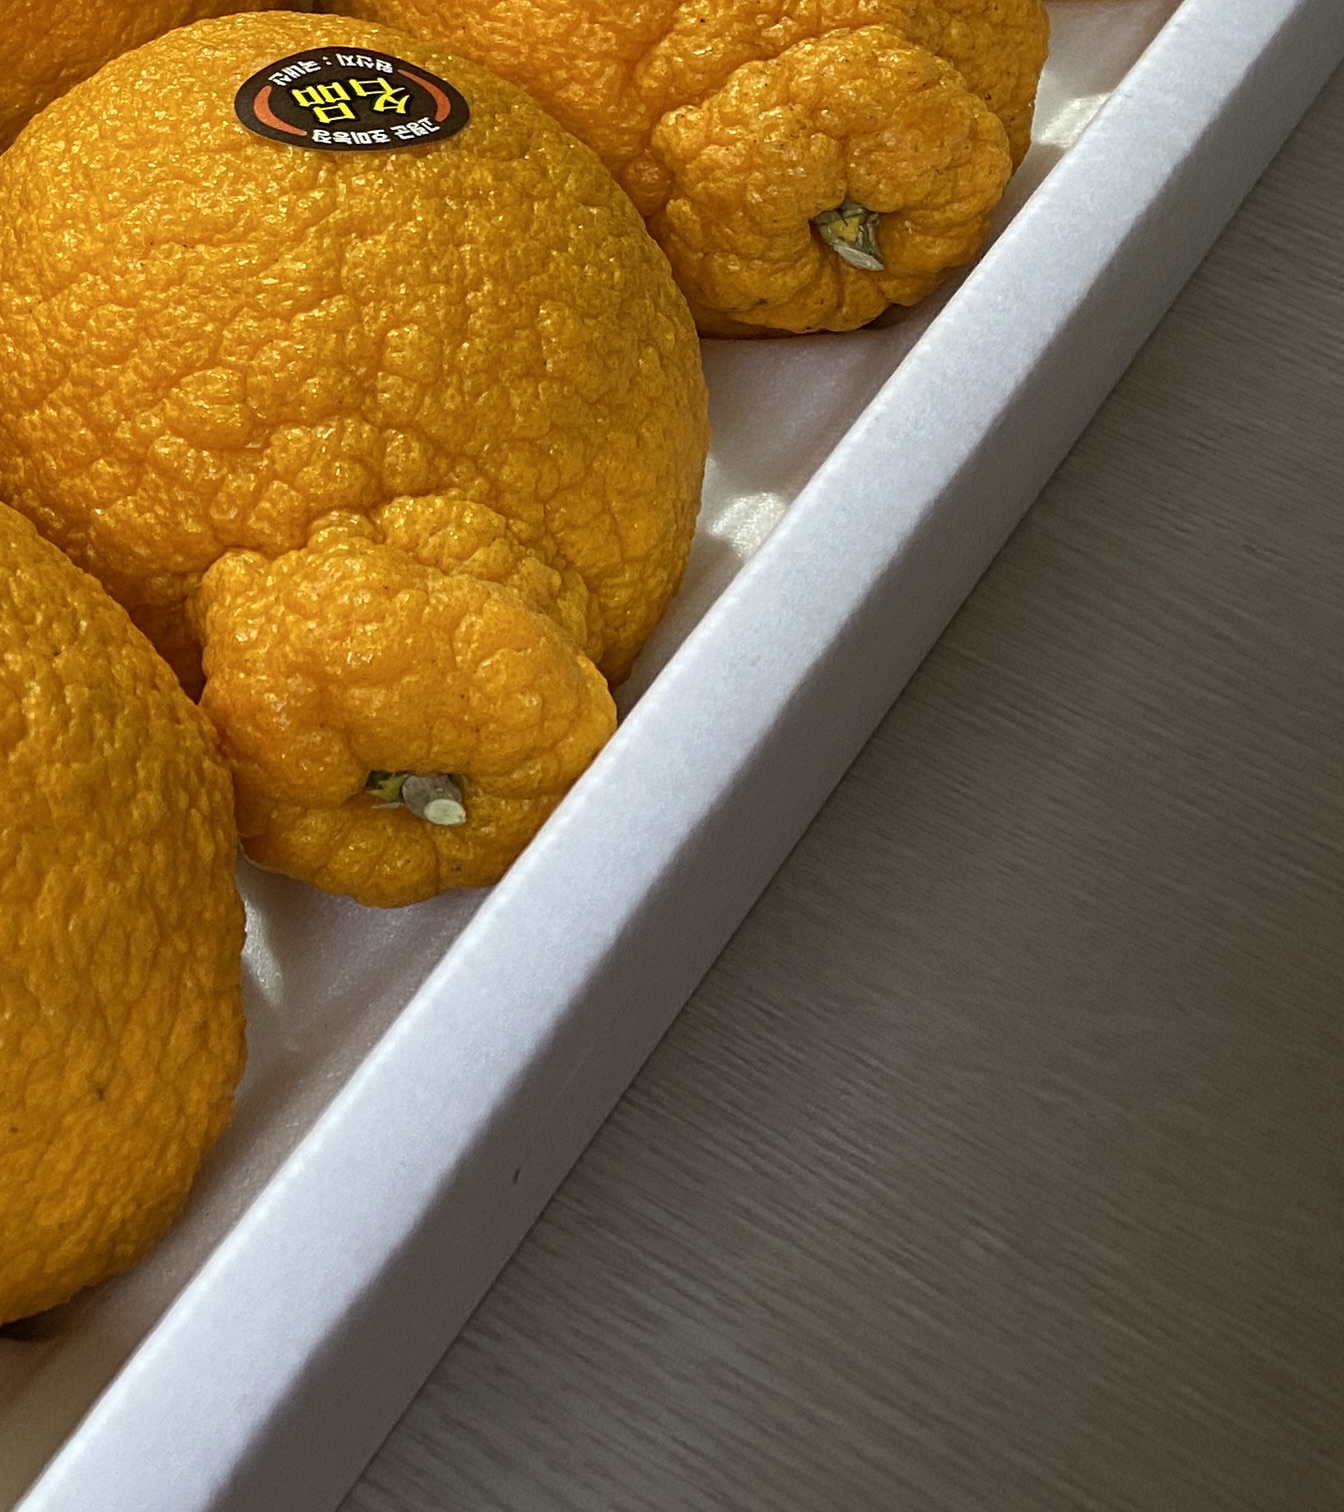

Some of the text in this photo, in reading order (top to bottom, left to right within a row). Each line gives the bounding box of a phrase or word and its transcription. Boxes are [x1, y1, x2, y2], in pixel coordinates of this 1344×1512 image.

[269, 61, 321, 86] 국내산
[336, 54, 393, 74] 원산지
[292, 77, 411, 123] 名品
[312, 116, 441, 145] 고령군 호미농장
